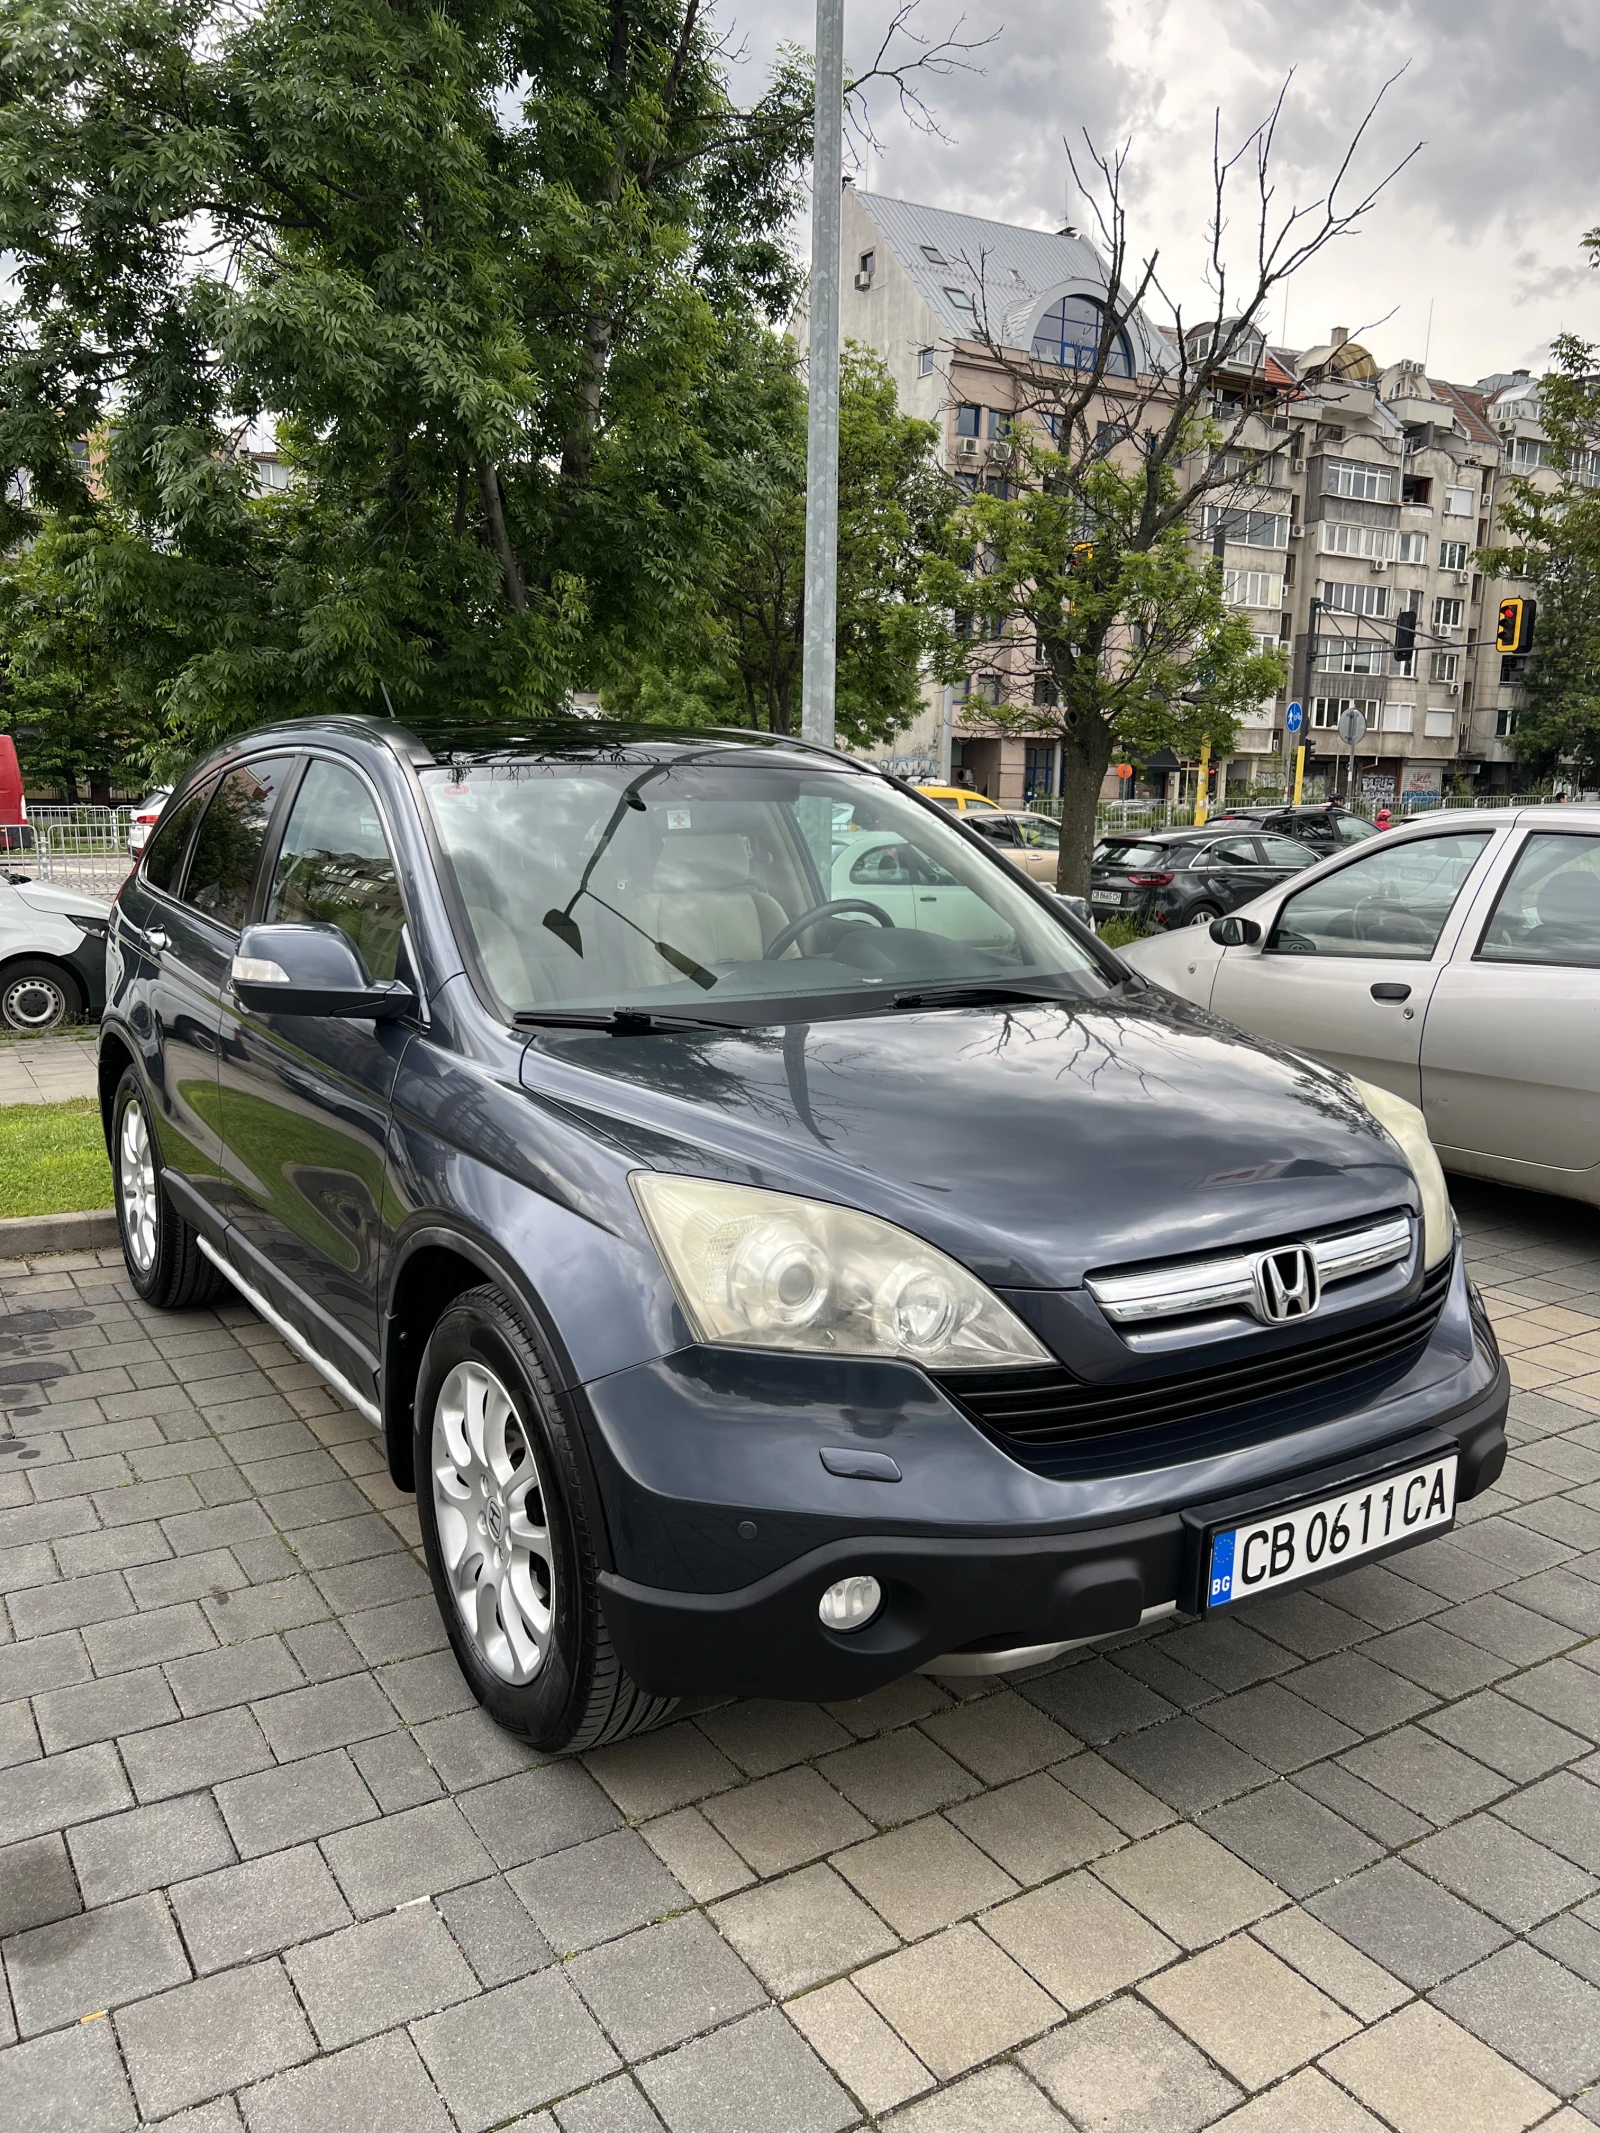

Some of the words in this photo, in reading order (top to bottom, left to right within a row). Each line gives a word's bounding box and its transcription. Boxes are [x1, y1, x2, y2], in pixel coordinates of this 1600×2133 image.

[1241, 1522, 1295, 1585] CB
[1306, 1485, 1395, 1563] 0611
[1403, 1468, 1447, 1527] CA
[1211, 1575, 1231, 1596] BG
